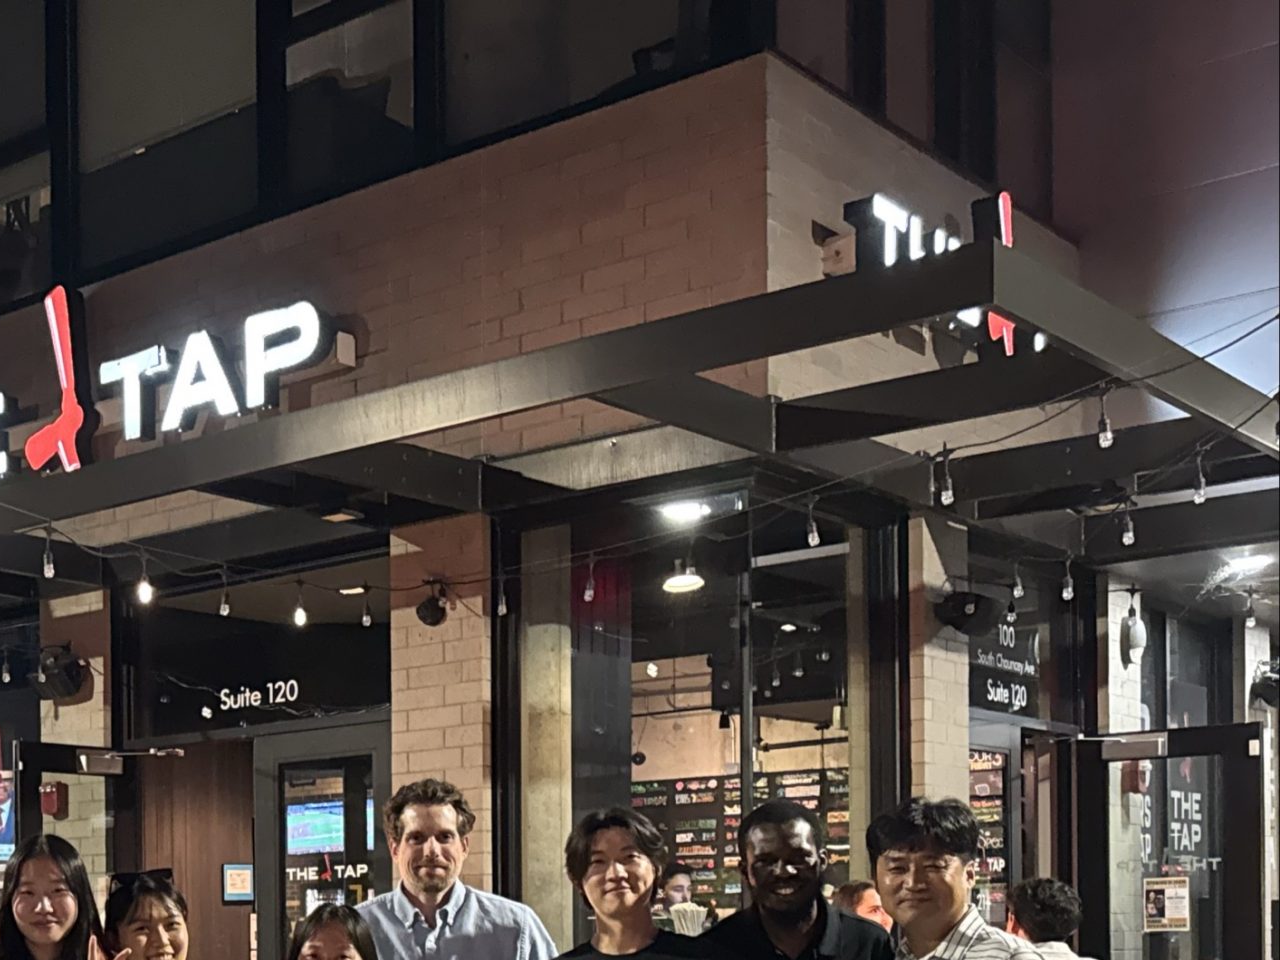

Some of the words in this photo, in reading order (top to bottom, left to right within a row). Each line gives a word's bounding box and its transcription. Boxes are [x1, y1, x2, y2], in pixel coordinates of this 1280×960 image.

[100, 301, 321, 440] TAP
[998, 624, 1015, 648] 100
[977, 648, 995, 667] South
[220, 686, 262, 710] Suite
[266, 680, 299, 704] 120
[987, 679, 1009, 704] Suite
[1010, 684, 1027, 707] 120
[1170, 790, 1202, 820] THE
[1170, 822, 1202, 851] TAP
[285, 866, 319, 881] THE
[334, 864, 368, 879] TAP
[986, 856, 1006, 873] TAP
